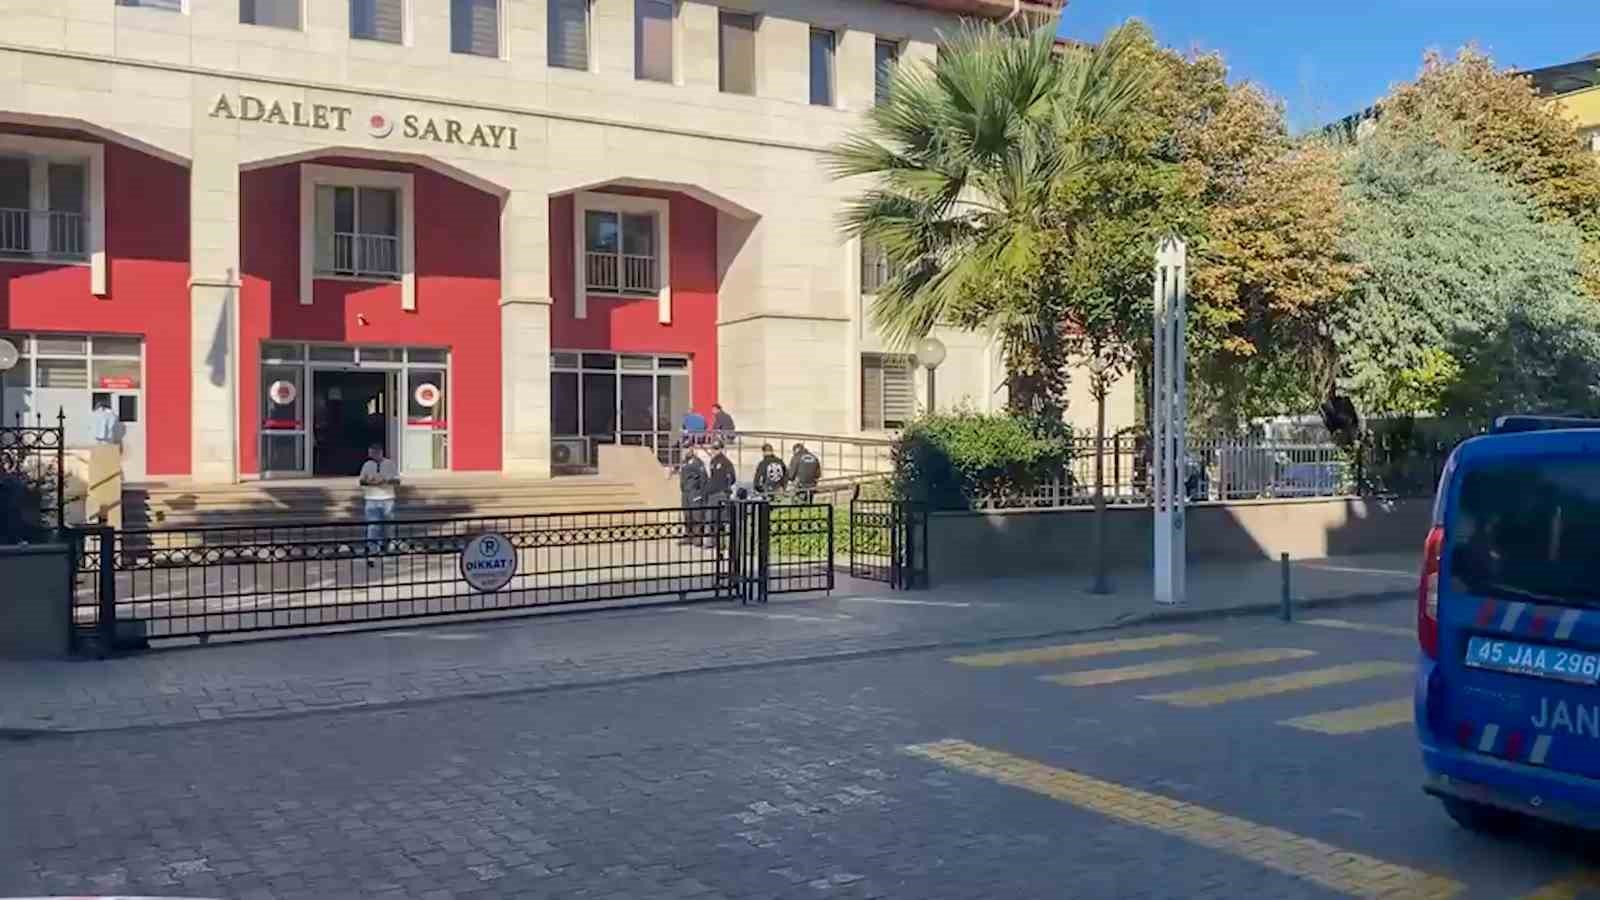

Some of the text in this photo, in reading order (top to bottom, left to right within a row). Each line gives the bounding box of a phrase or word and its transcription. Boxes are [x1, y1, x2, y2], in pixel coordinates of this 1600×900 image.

[208, 93, 518, 150] ADALET SARAYI
[1478, 641, 1504, 662] 45
[1508, 645, 1545, 669] JAA
[1531, 697, 1600, 739] JAN
